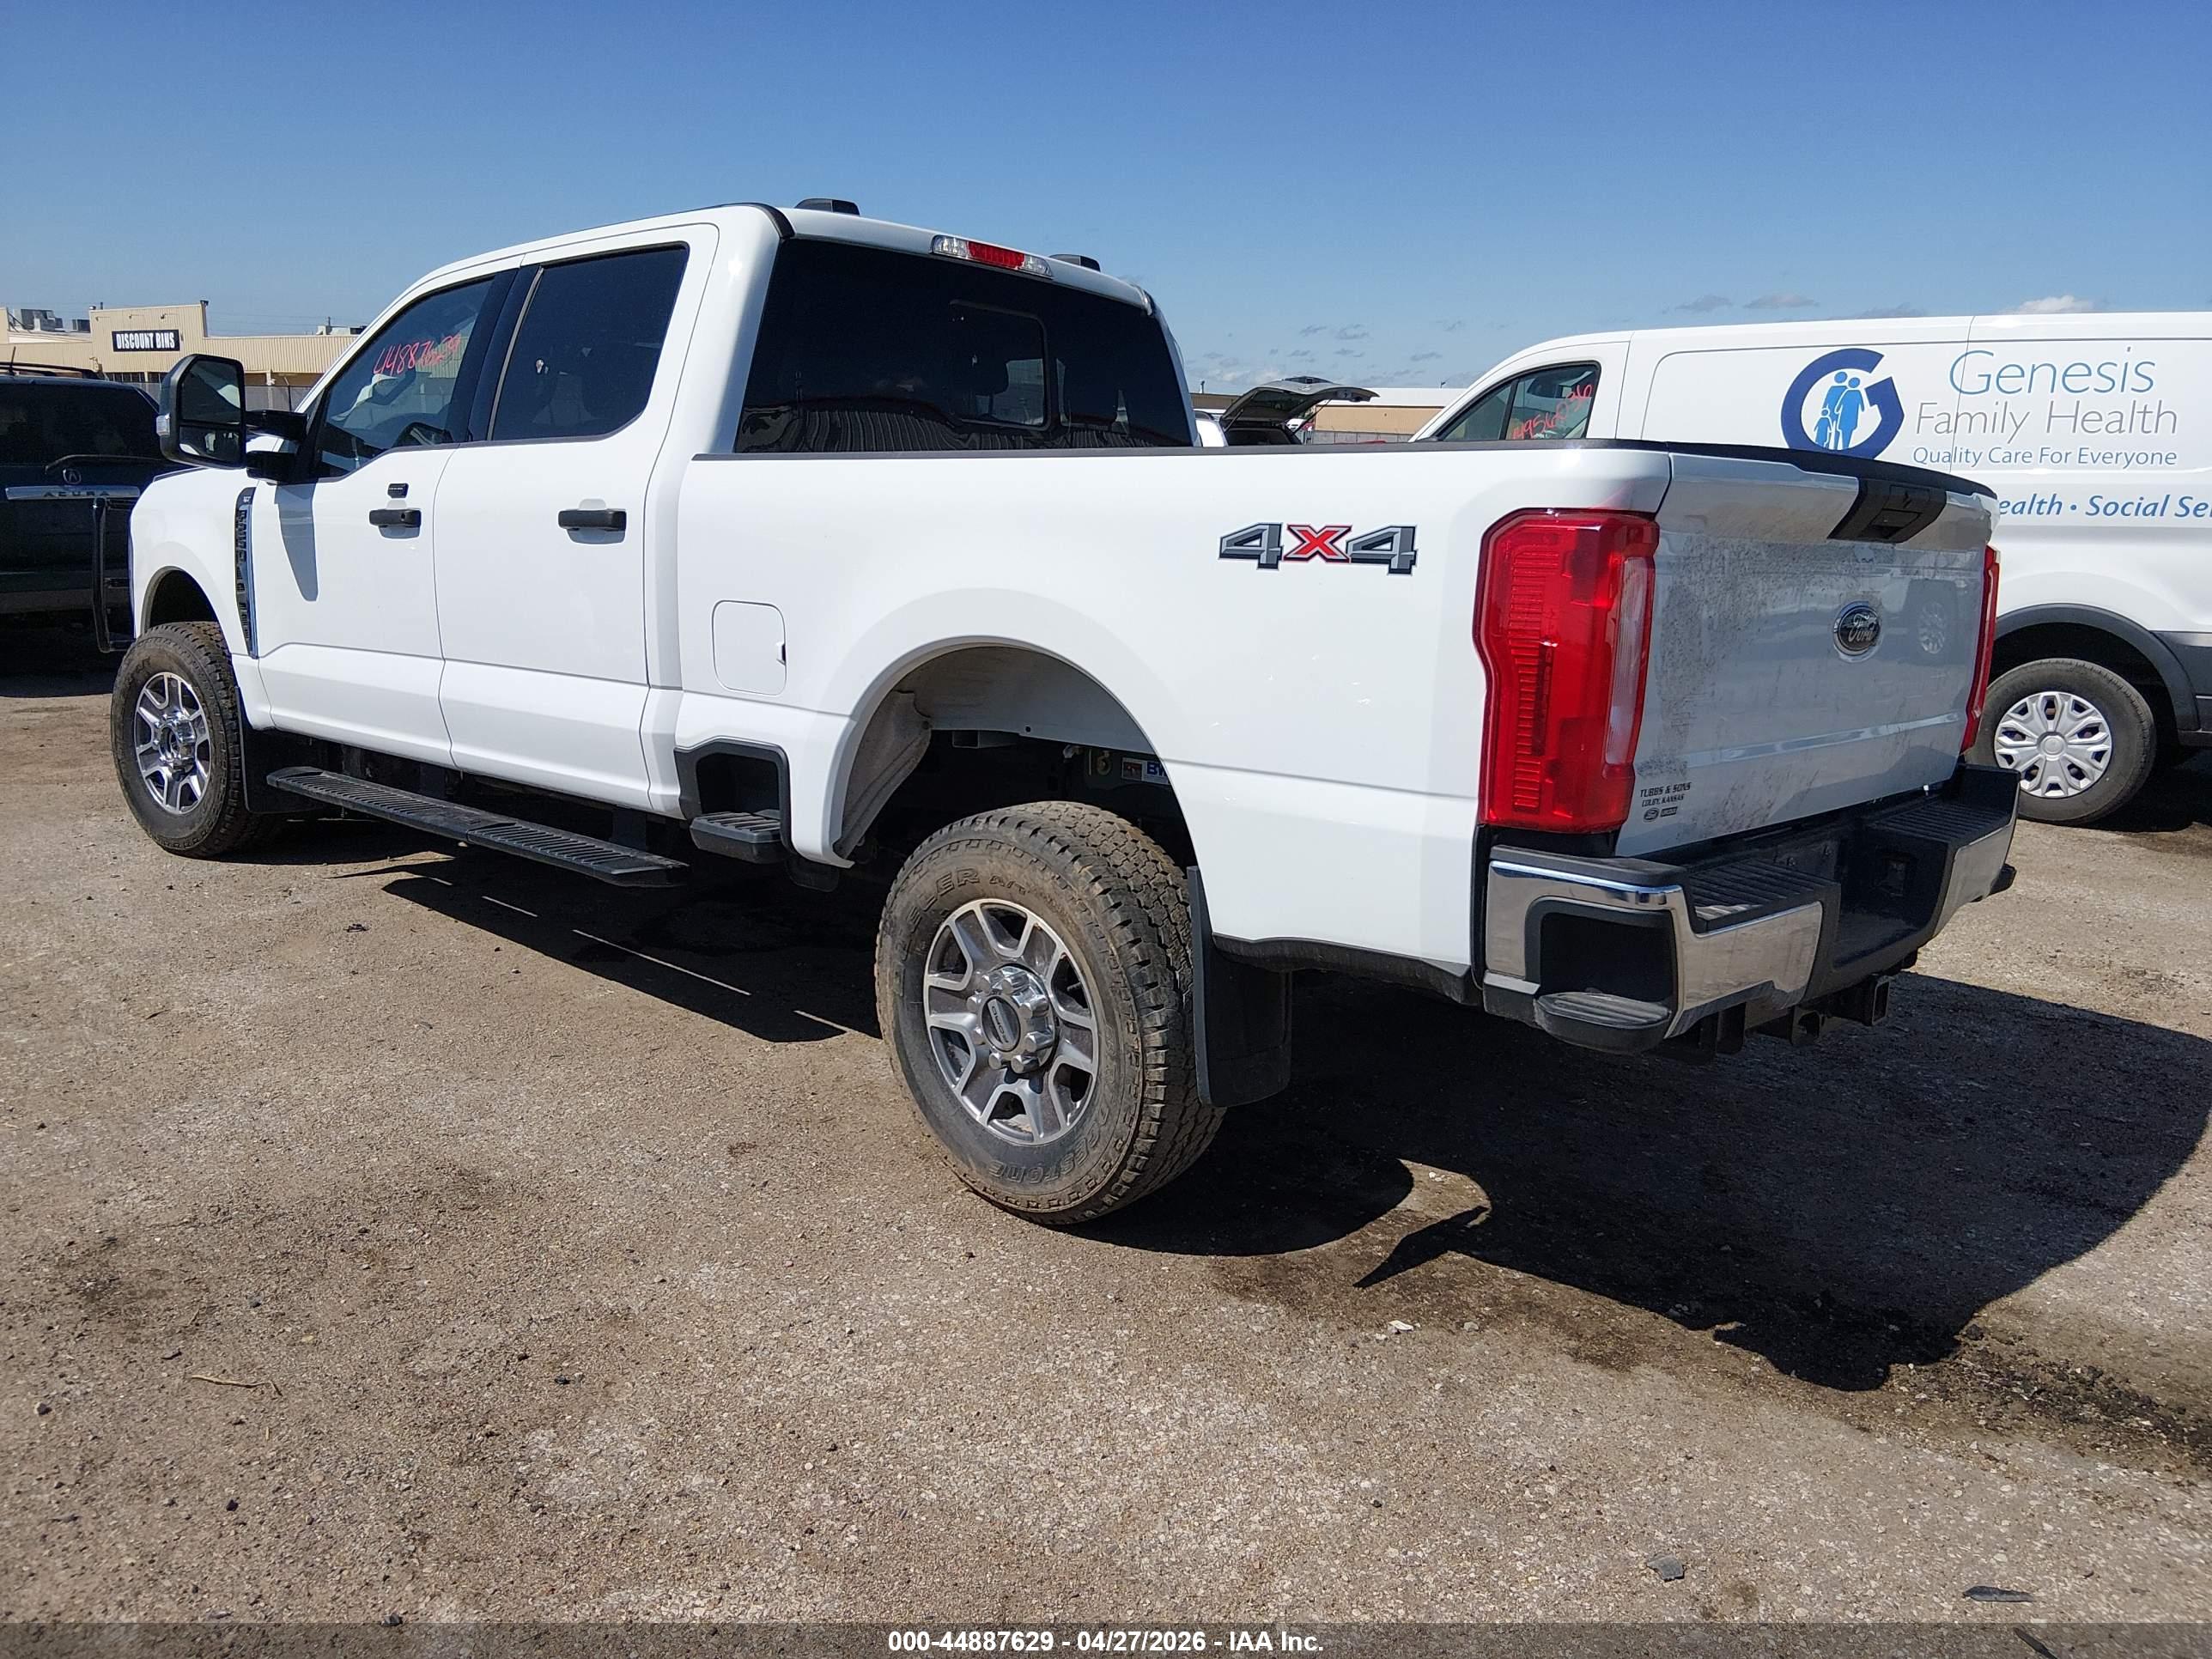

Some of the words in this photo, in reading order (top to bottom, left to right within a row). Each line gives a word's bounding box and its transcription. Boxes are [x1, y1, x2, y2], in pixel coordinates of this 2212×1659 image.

[115, 332, 154, 349] DISCOUNT
[155, 331, 175, 349] BINS
[1949, 346, 2155, 395] Genesis
[1916, 400, 2030, 445] Family
[2046, 399, 2178, 434] Health
[1913, 447, 1983, 468] Quality
[1988, 447, 2033, 464] Care
[2039, 447, 2071, 465] For
[2078, 447, 2178, 470] Everyone
[2085, 494, 2170, 518] Social
[2174, 495, 2212, 519] Se
[1848, 612, 1877, 642] Ford
[1641, 787, 1664, 797] TUBBS
[1673, 782, 1692, 793] SONS
[991, 1006, 1010, 1043] FORD
